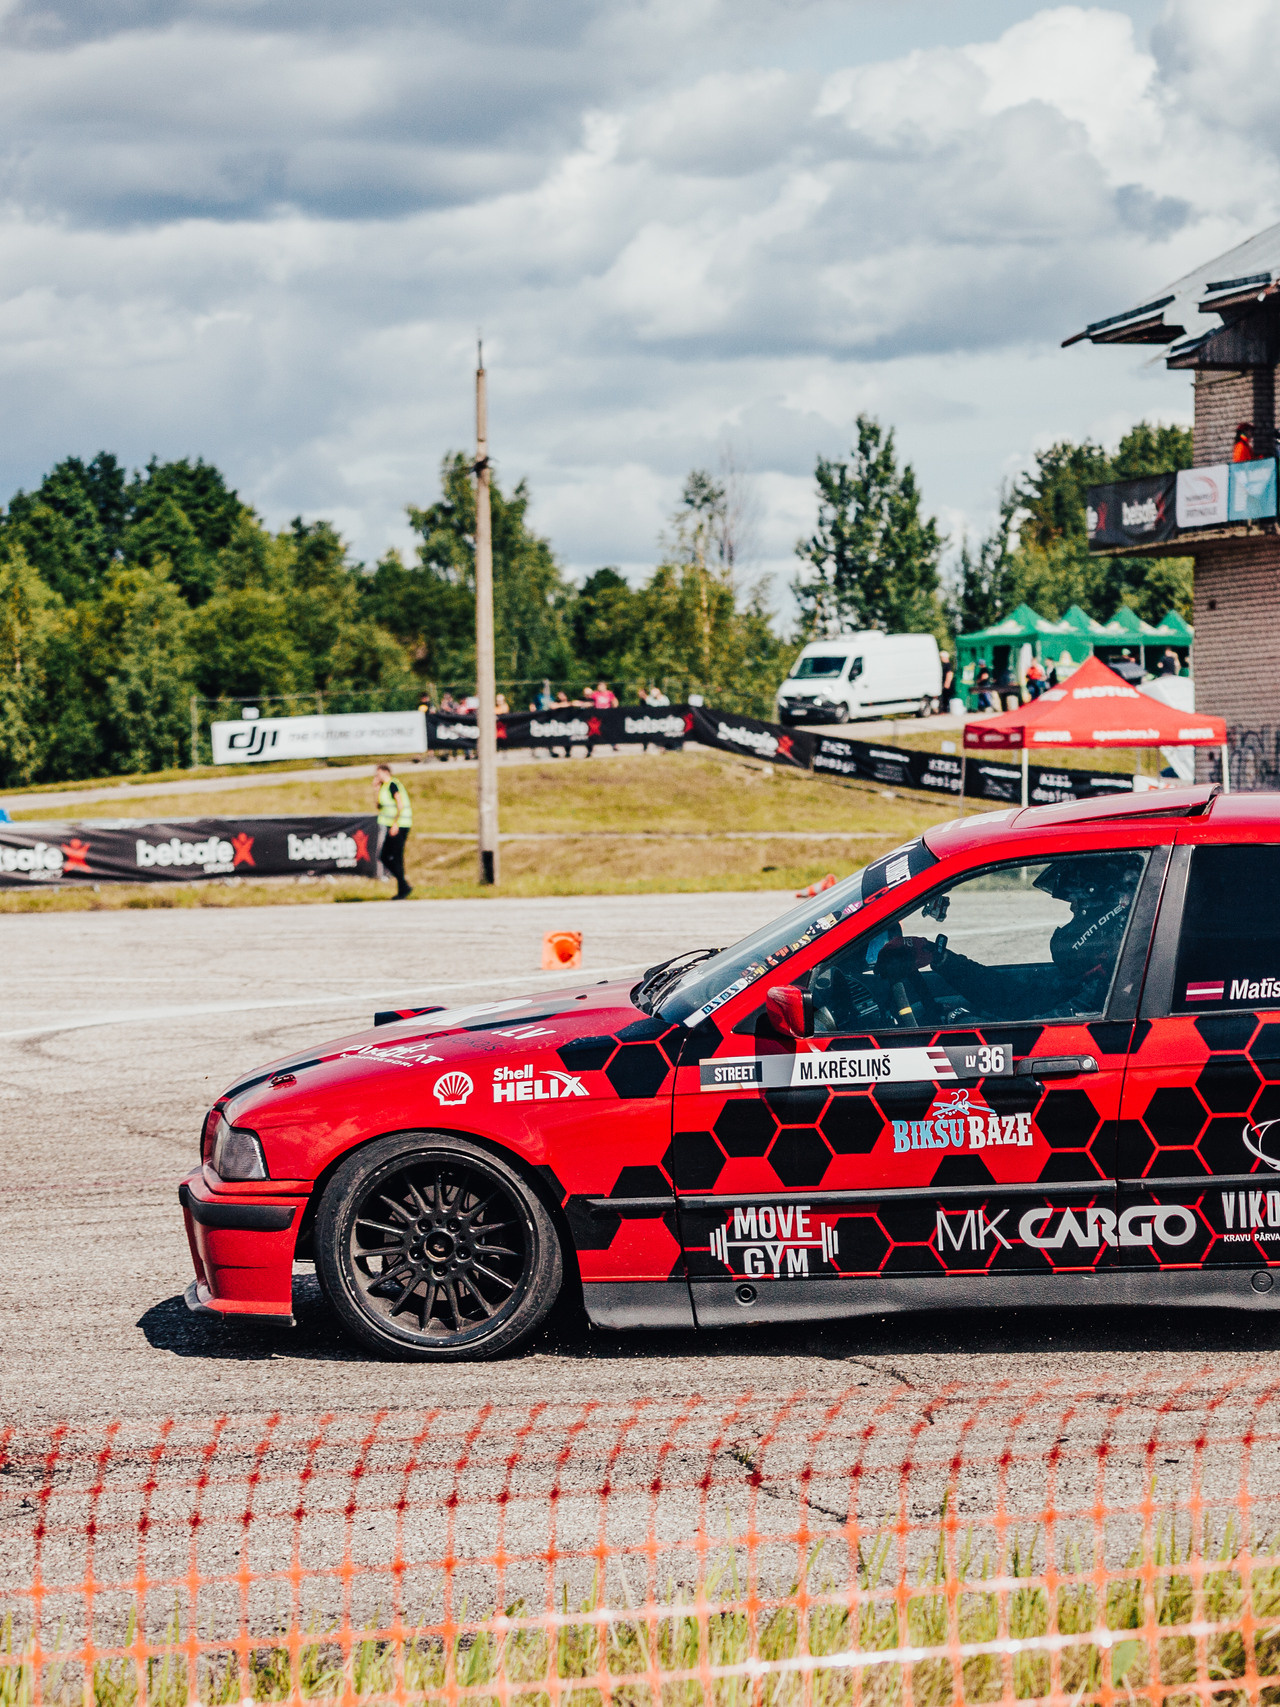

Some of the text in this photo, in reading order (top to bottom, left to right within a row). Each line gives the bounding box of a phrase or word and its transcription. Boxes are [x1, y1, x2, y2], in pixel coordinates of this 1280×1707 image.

[136, 836, 235, 867] betsafe
[288, 832, 357, 861] betsafe
[493, 1064, 534, 1081] Shell
[800, 1053, 891, 1082] M.KRĒSLIŅŠ
[966, 1046, 1005, 1073] LV 36
[492, 1074, 590, 1103] HELIX
[714, 1066, 756, 1083] STREET
[891, 1109, 1034, 1153] BIKŠU BĀZE
[734, 1206, 813, 1239] MOVE
[936, 1204, 1196, 1251] MK CARGO
[1223, 1234, 1251, 1242] KRAVU
[743, 1246, 809, 1278] GYM
